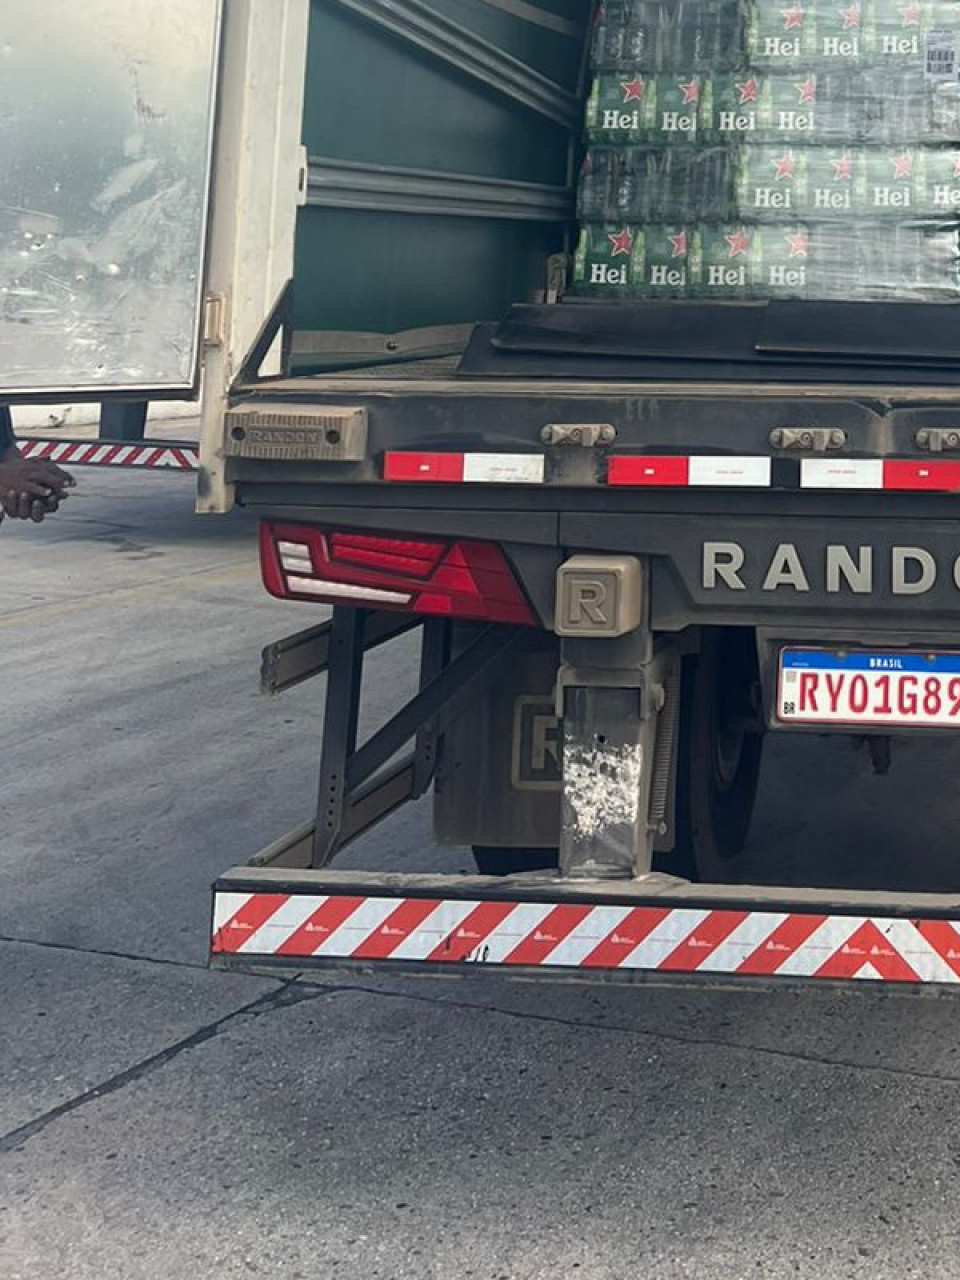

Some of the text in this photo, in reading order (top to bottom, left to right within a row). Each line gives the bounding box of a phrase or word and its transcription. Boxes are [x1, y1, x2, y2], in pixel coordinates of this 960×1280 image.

[765, 38, 800, 55] Hei
[823, 38, 858, 55] Hei
[882, 36, 918, 54] Hei
[603, 111, 814, 130] Hei Hei Hei Hei
[754, 189, 791, 207] Hei
[815, 189, 850, 207] Hei
[874, 188, 910, 205] Hei
[591, 265, 805, 285] Hei Hei Hei Hei
[567, 580, 607, 625] R
[870, 658, 903, 669] BRASIL
